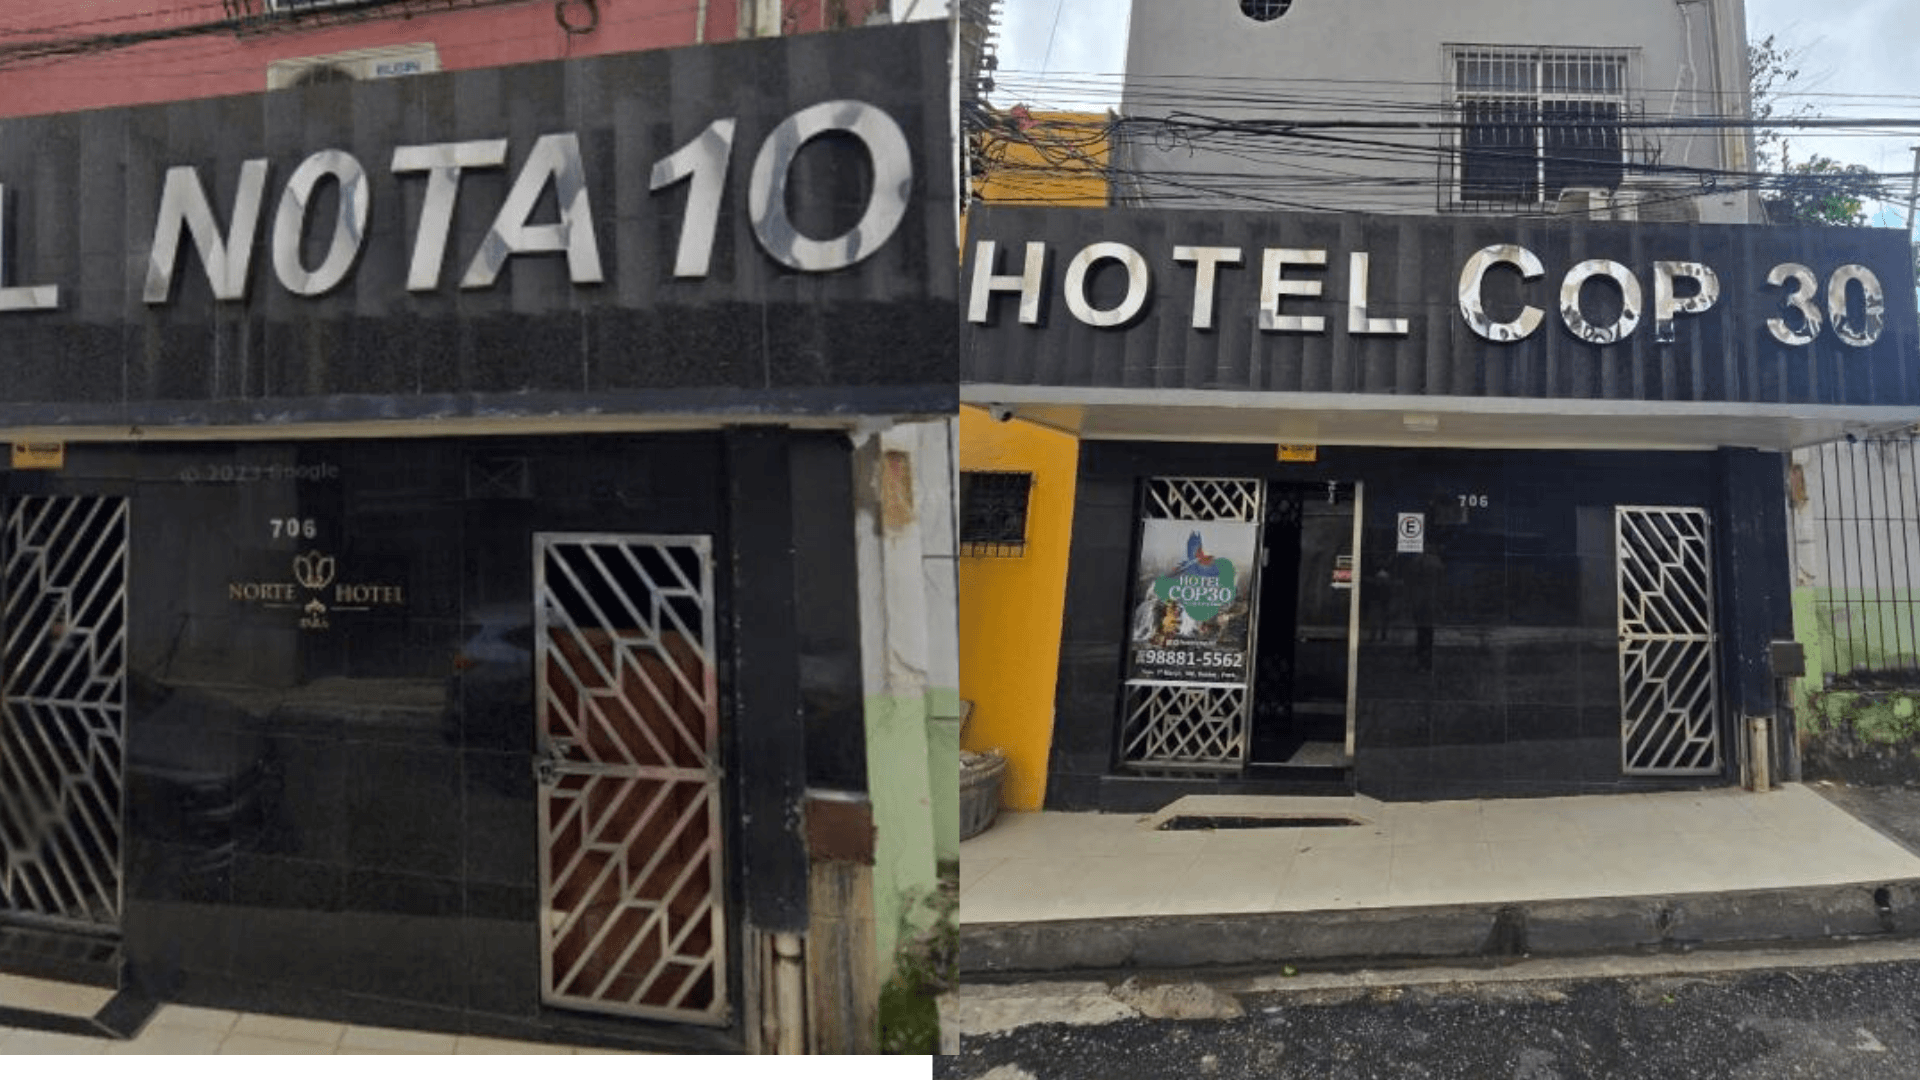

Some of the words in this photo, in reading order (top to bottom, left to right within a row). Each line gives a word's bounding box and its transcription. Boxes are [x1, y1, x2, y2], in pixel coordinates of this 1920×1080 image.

[142, 132, 603, 304] NOTA
[649, 99, 912, 278] 10
[967, 240, 1410, 335] HOTEL
[1766, 262, 1884, 348] 30
[1458, 494, 1488, 508] 706
[269, 518, 317, 538] 706
[1179, 575, 1219, 587] HOTEL
[229, 582, 296, 600] NORTE
[335, 584, 403, 603] HOTEL
[1168, 585, 1232, 602] COP30
[1146, 651, 1242, 667] 98881-5562
